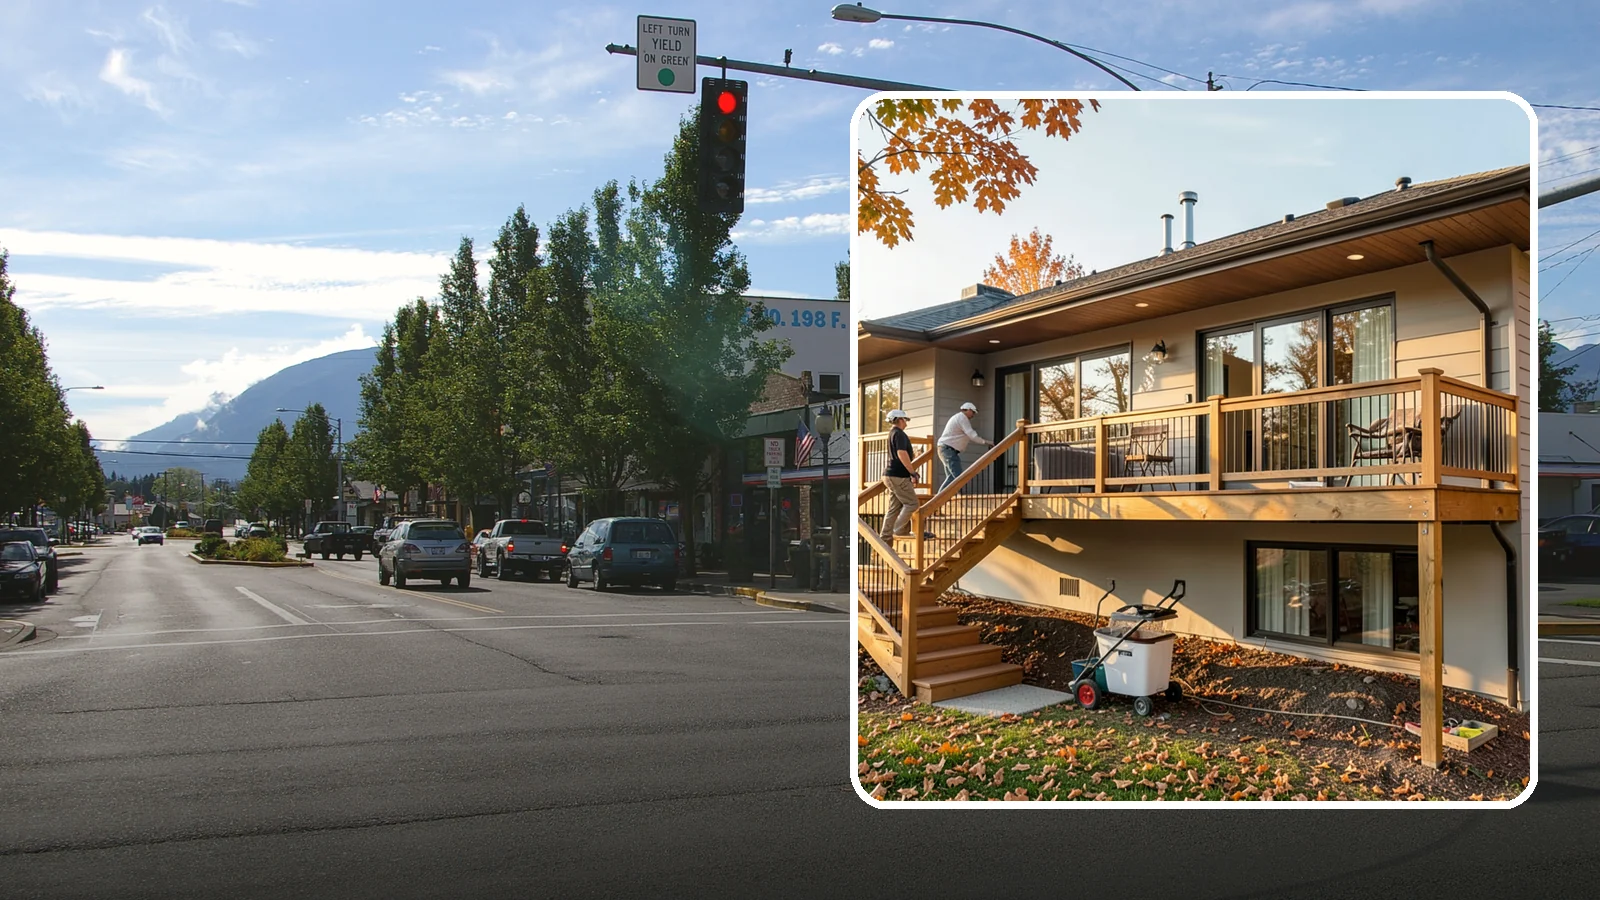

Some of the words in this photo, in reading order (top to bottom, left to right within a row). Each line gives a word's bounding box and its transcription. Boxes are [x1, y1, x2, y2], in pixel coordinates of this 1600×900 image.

[642, 23, 663, 34] LEFT
[668, 25, 690, 36] TURN
[652, 38, 682, 52] YIELD
[643, 53, 656, 64] ON
[660, 54, 688, 66] GREEN
[791, 309, 826, 328] 198
[831, 311, 847, 329] F.
